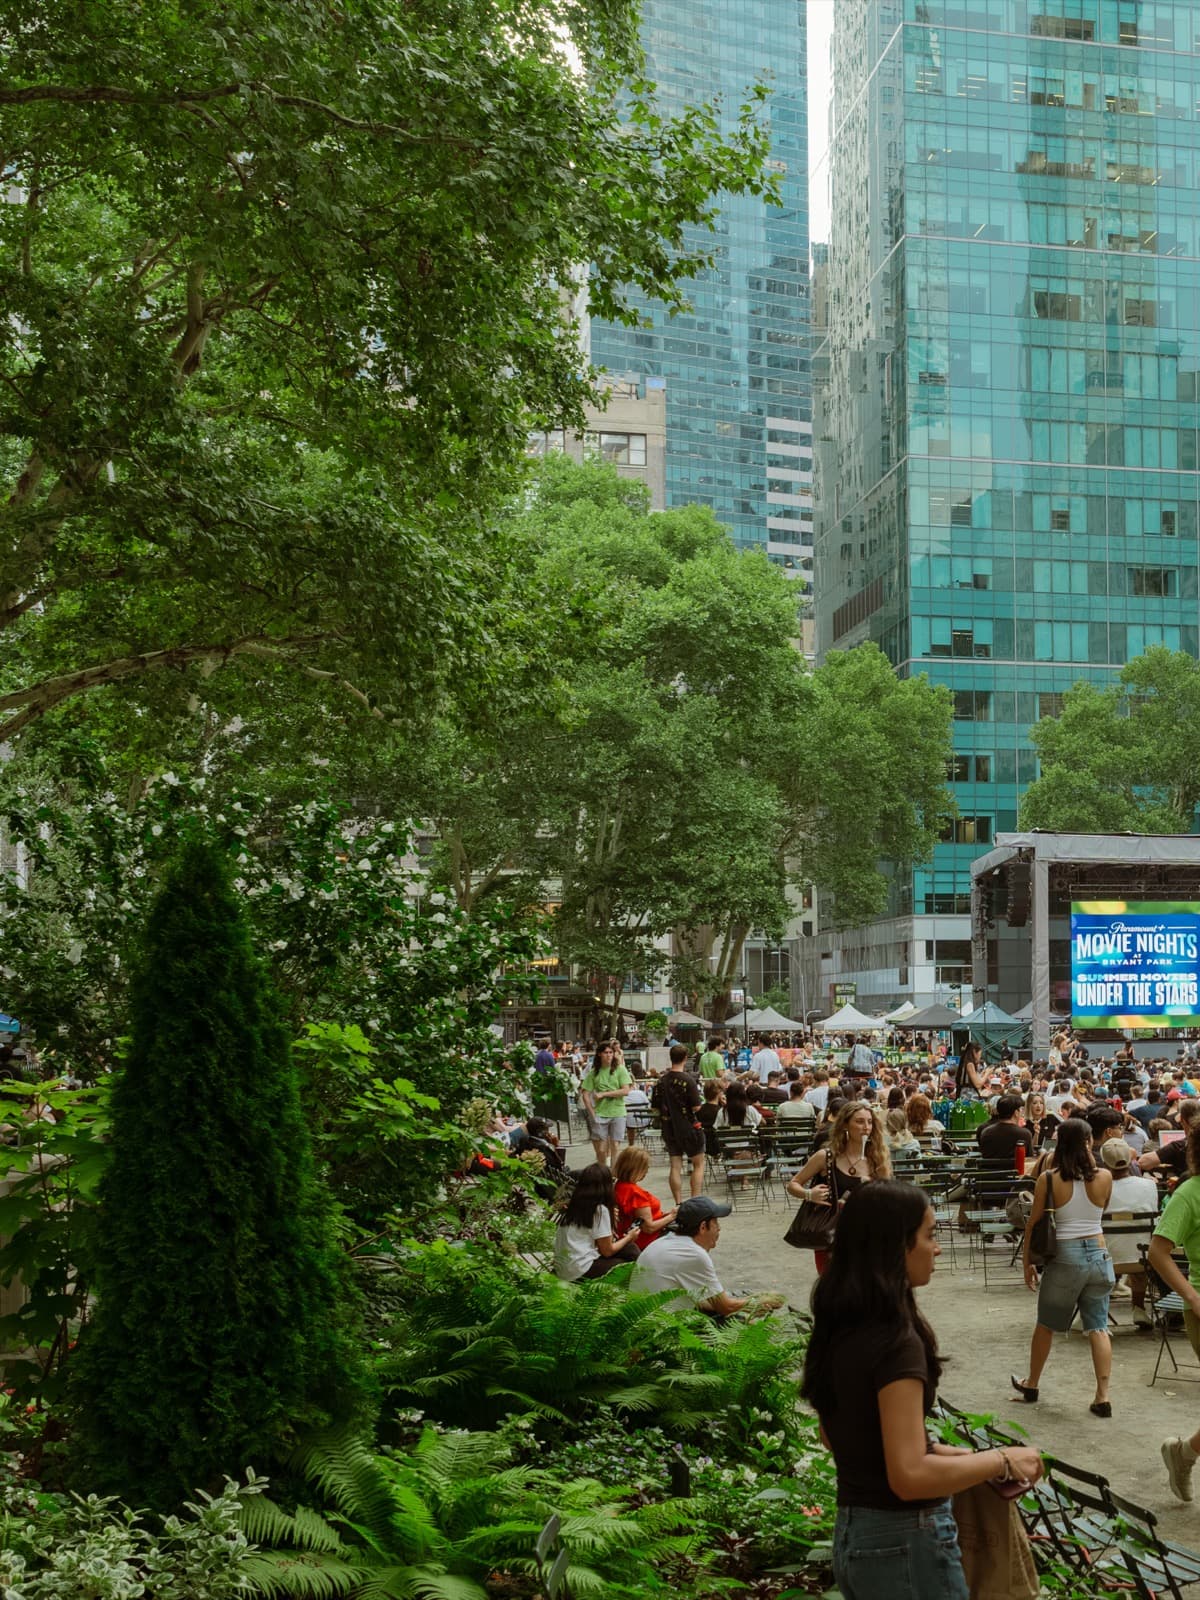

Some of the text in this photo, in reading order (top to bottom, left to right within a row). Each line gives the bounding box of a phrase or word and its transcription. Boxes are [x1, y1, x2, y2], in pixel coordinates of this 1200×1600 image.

[1109, 922, 1166, 934] Paramount+
[1076, 933, 1198, 960] MOVIE NIGHTS
[1077, 973, 1198, 982] SUMMER MOVIES
[1077, 982, 1198, 1006] UNDER THE STARS
